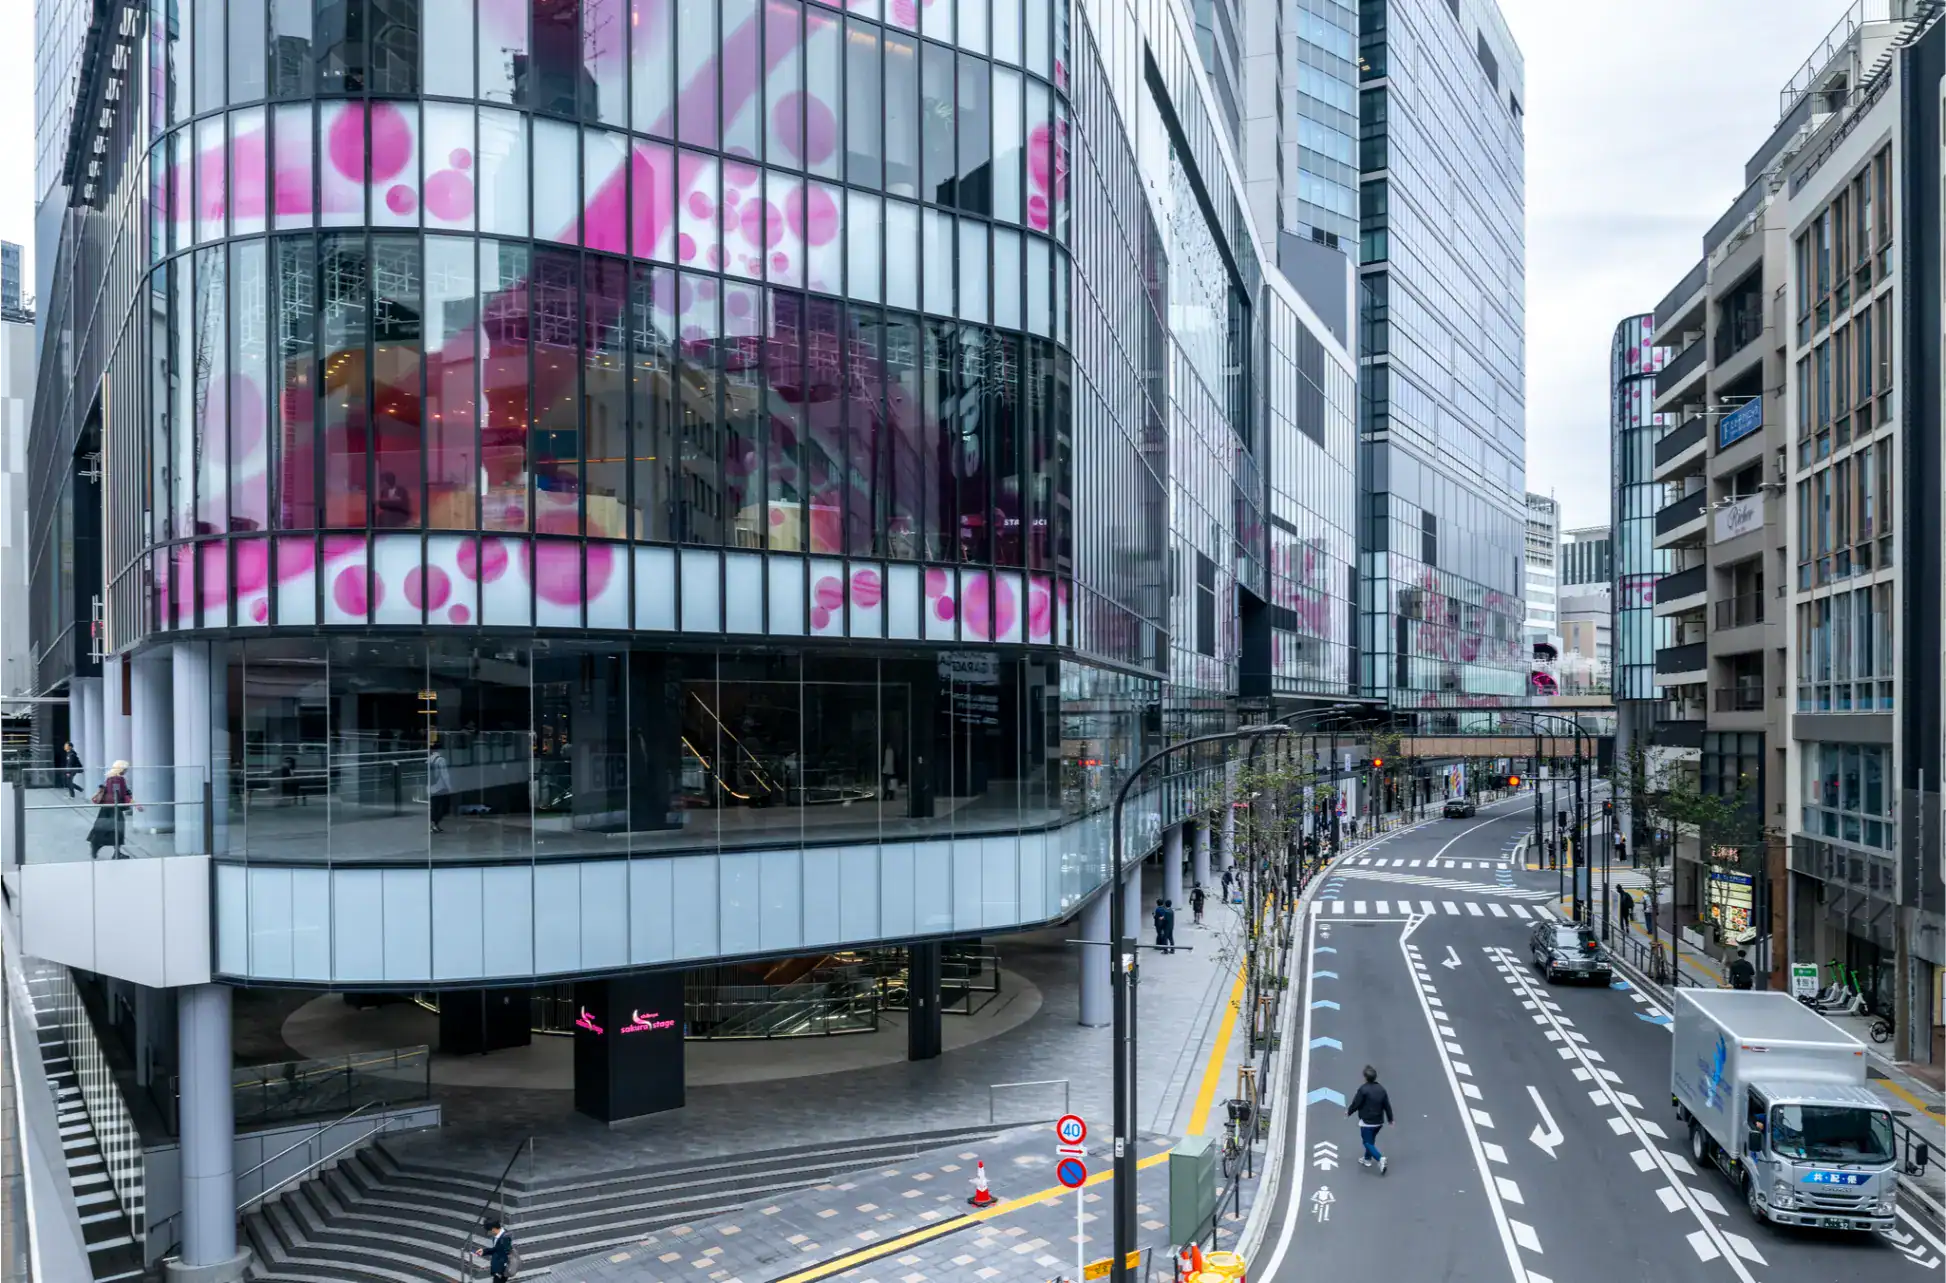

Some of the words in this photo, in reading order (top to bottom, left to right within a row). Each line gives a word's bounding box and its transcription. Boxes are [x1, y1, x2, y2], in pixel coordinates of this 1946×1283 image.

[621, 1024, 649, 1033] sakura
[652, 1019, 675, 1029] stage
[1063, 1123, 1081, 1138] 40
